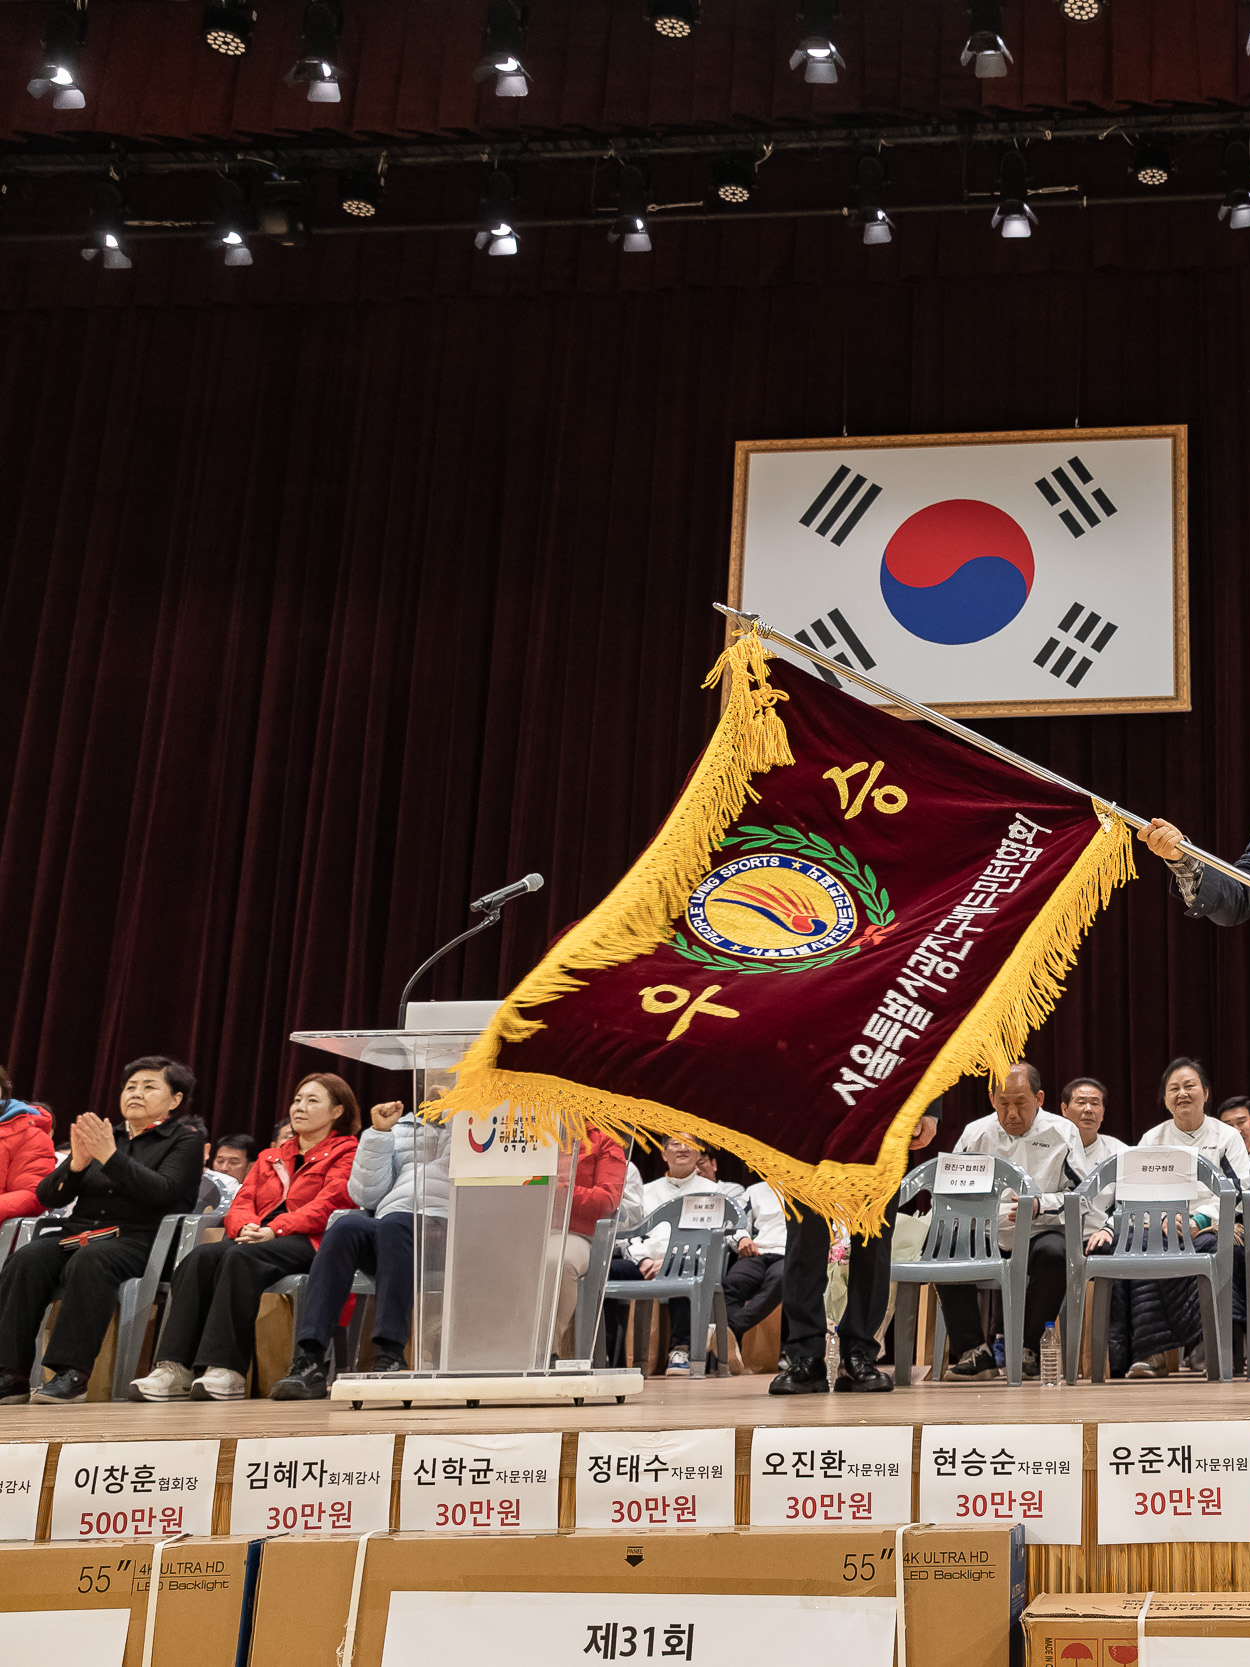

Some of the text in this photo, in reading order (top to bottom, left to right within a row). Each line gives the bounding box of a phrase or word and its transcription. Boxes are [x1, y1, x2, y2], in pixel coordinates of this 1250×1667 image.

[822, 760, 908, 819] 승
[689, 906, 725, 944] PEOPLE
[720, 856, 780, 878] SPORTS
[267, 1501, 351, 1529] 30만원
[437, 1499, 520, 1526] 30만원
[612, 1496, 696, 1523] 30만원
[787, 1493, 871, 1520] 30만원
[957, 1491, 1042, 1518] 30만원
[1135, 1488, 1221, 1515] 30만원
[80, 1507, 182, 1534] 500만원
[161, 1562, 202, 1574] ULTRA
[205, 1561, 225, 1573] HD
[923, 1552, 967, 1563] ULTRA
[970, 1551, 989, 1563] HD
[168, 1580, 229, 1592] Backlight
[934, 1570, 996, 1582] Backlight
[583, 1622, 695, 1662] 제31회
[1044, 1638, 1053, 1665] MADE IN
